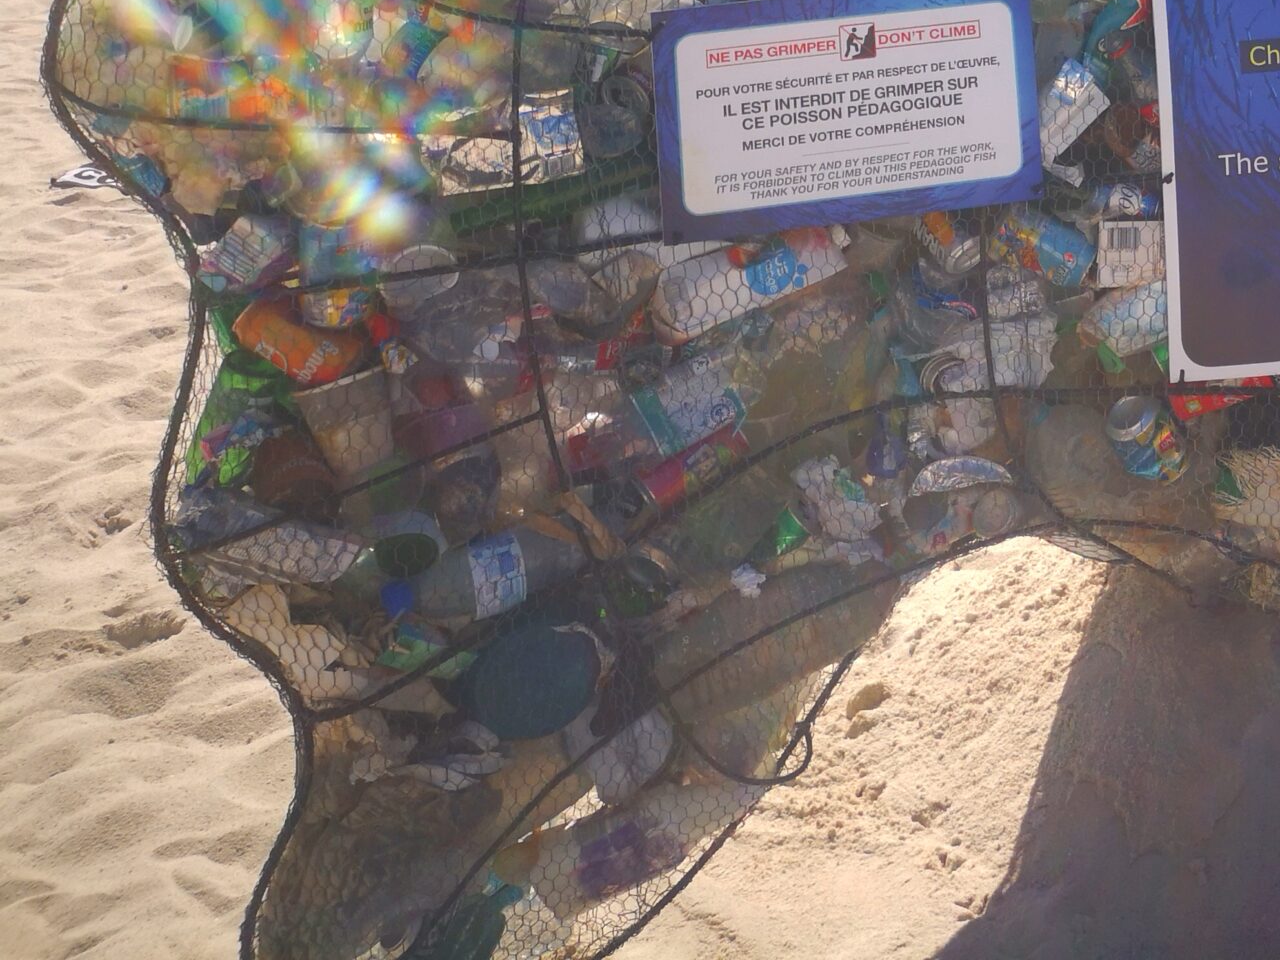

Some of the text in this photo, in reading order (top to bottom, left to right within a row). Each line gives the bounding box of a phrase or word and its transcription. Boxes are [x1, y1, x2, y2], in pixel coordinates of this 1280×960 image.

[709, 39, 835, 63] NE PAS GRIMPER
[878, 24, 976, 44] DON'T CLIMB
[695, 86, 729, 99] POUR
[732, 81, 772, 94] VOTRE
[775, 74, 832, 89] SÉCURITÉ
[835, 72, 849, 82] ET
[852, 70, 874, 80] PAR
[878, 63, 927, 77] RESPECT
[930, 61, 945, 72] DE
[723, 76, 978, 116] IL EST INTERDIT DE GRIMPER SUR
[742, 92, 962, 130] CE POISSON PÉDAGOGIQUE
[742, 115, 964, 150] MERCI DE VOTRE COMPRÉHENSION
[714, 173, 737, 184] FOR
[740, 168, 771, 180] YOUR
[774, 163, 816, 176] SAFETY
[818, 160, 841, 171] AND
[844, 158, 859, 167] BY
[861, 151, 910, 165] RESPECT
[912, 148, 934, 161] FOR
[937, 145, 959, 159] THE
[714, 151, 996, 194] IT IS FORBIDDEN TO CLIMB ON THIS PEDAGOGIC FISH
[1217, 151, 1269, 176] The
[750, 165, 963, 199] THANK YOU FOR YOUR UNDERSTANDING
